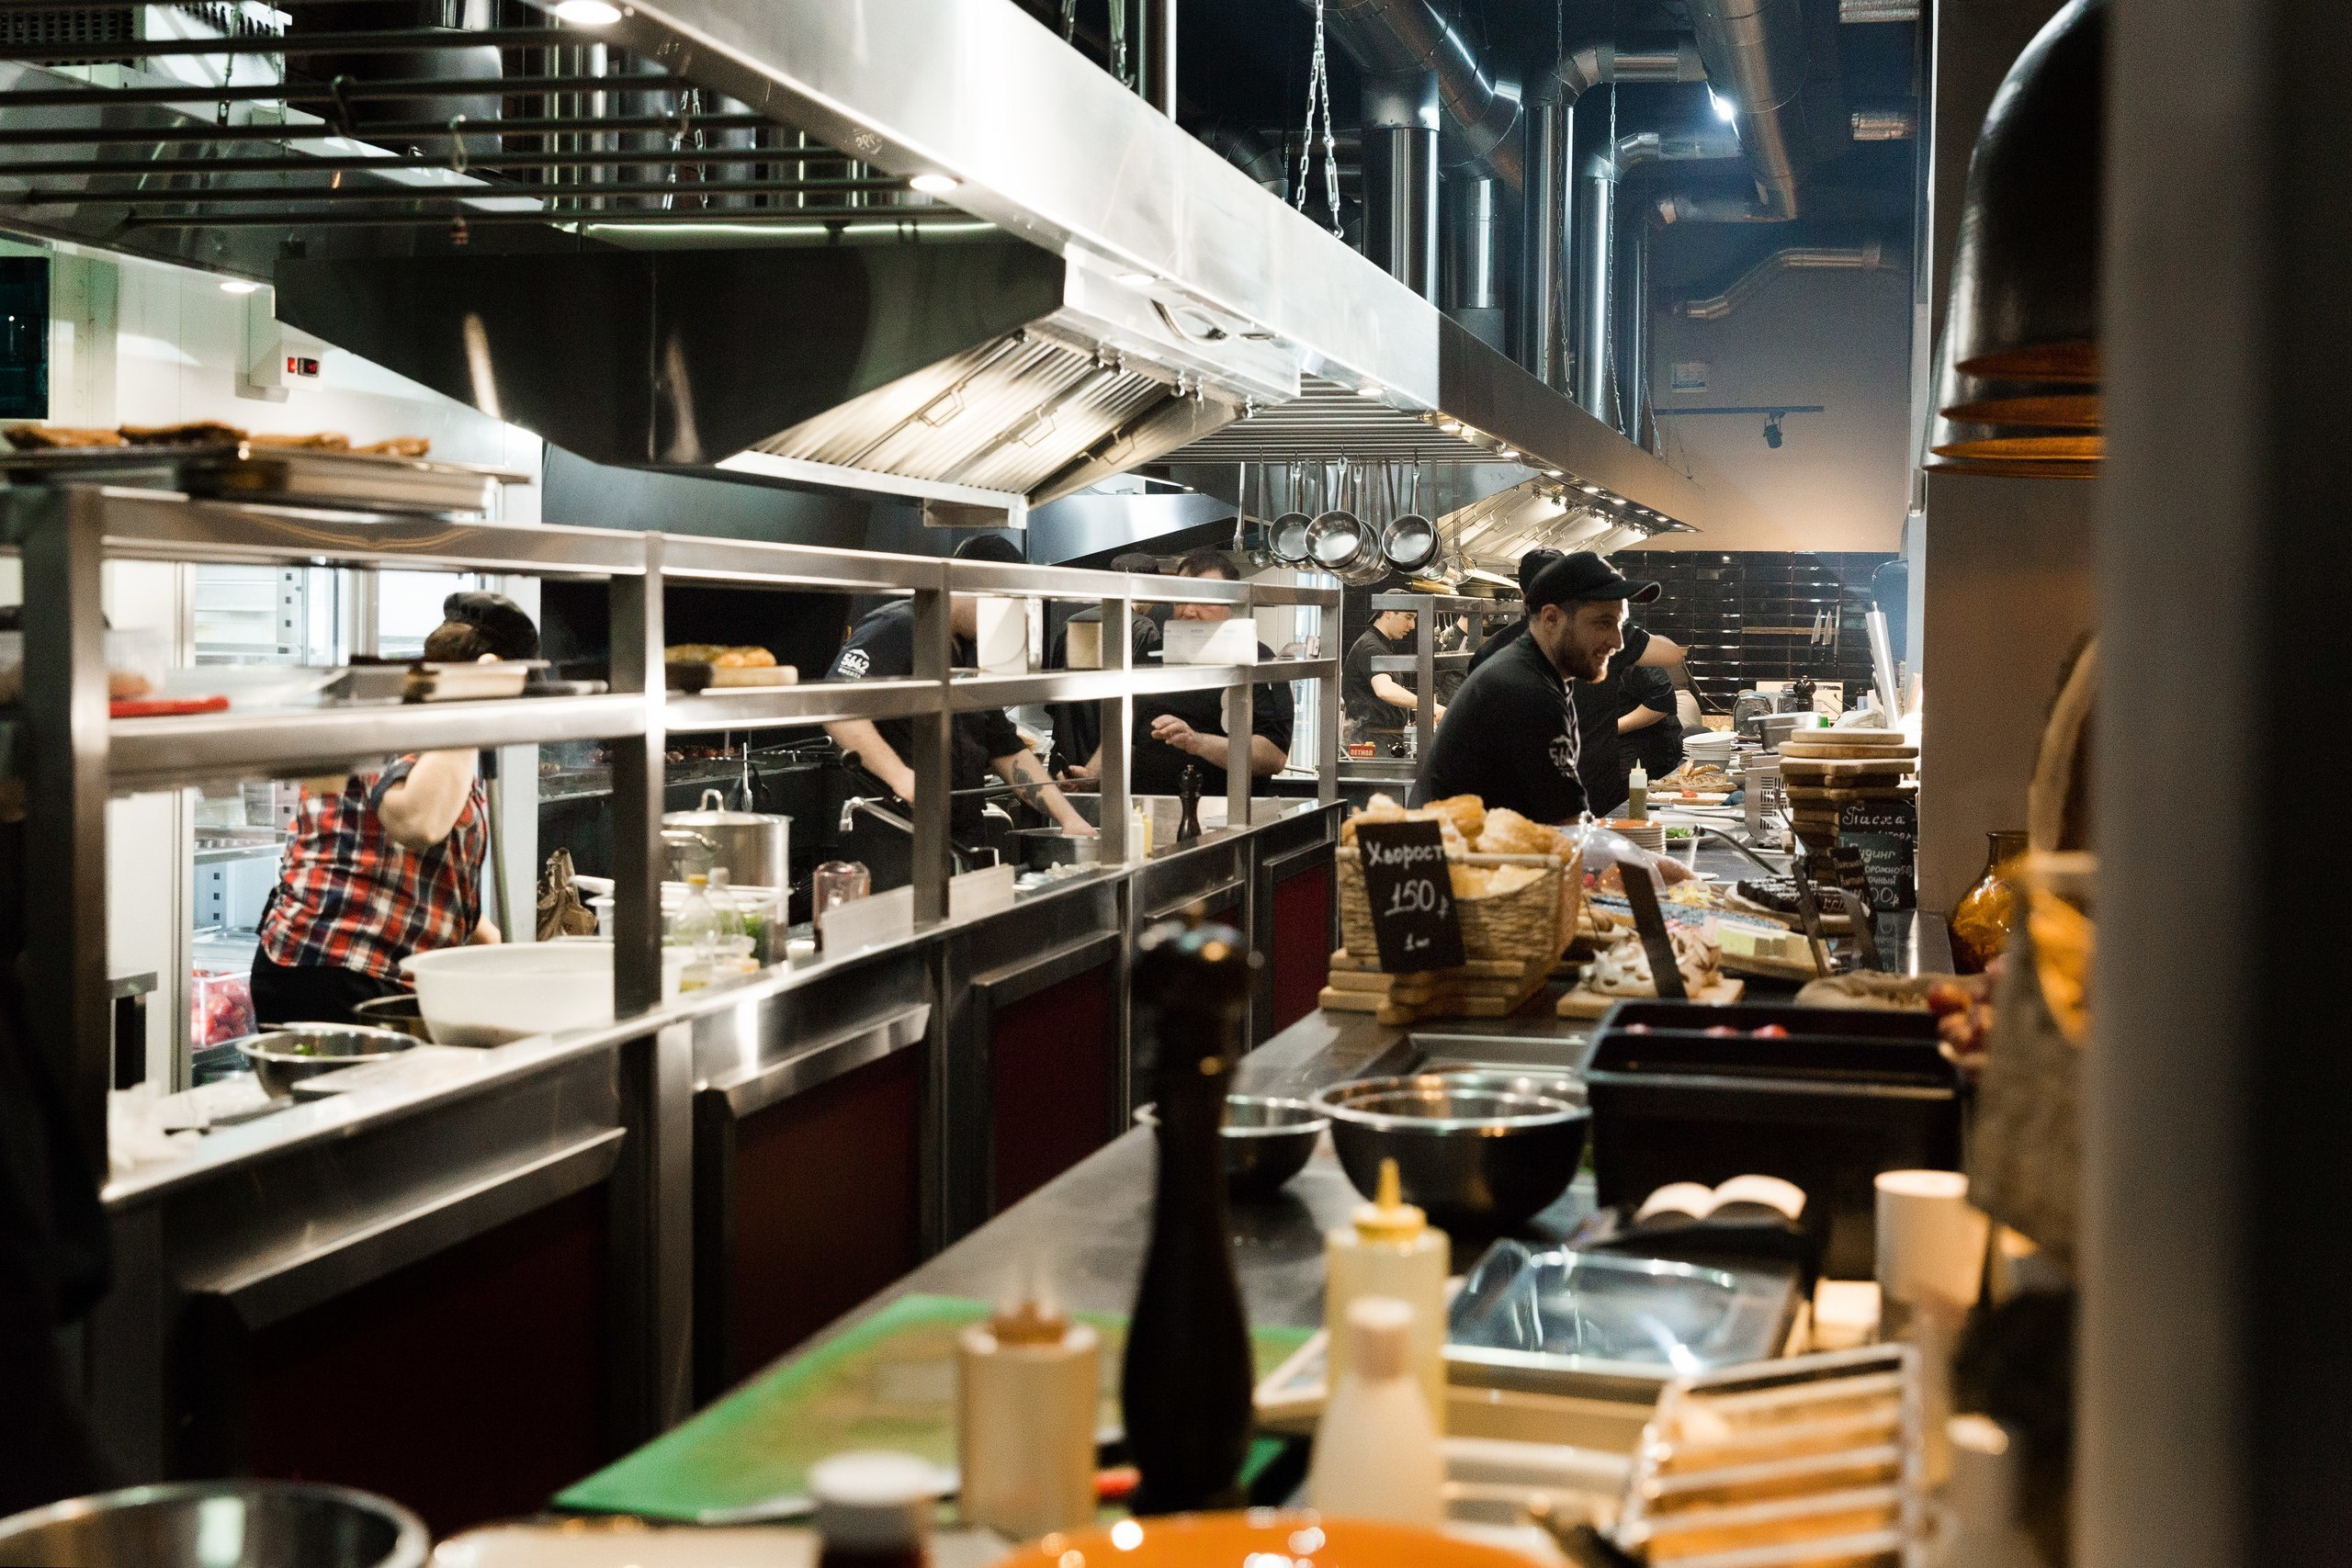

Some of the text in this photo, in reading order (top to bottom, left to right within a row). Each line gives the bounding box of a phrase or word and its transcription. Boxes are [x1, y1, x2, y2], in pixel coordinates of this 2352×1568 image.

[841, 653, 869, 675] 5642
[1365, 840, 1445, 870] Хворост
[1849, 842, 1895, 863] удинг
